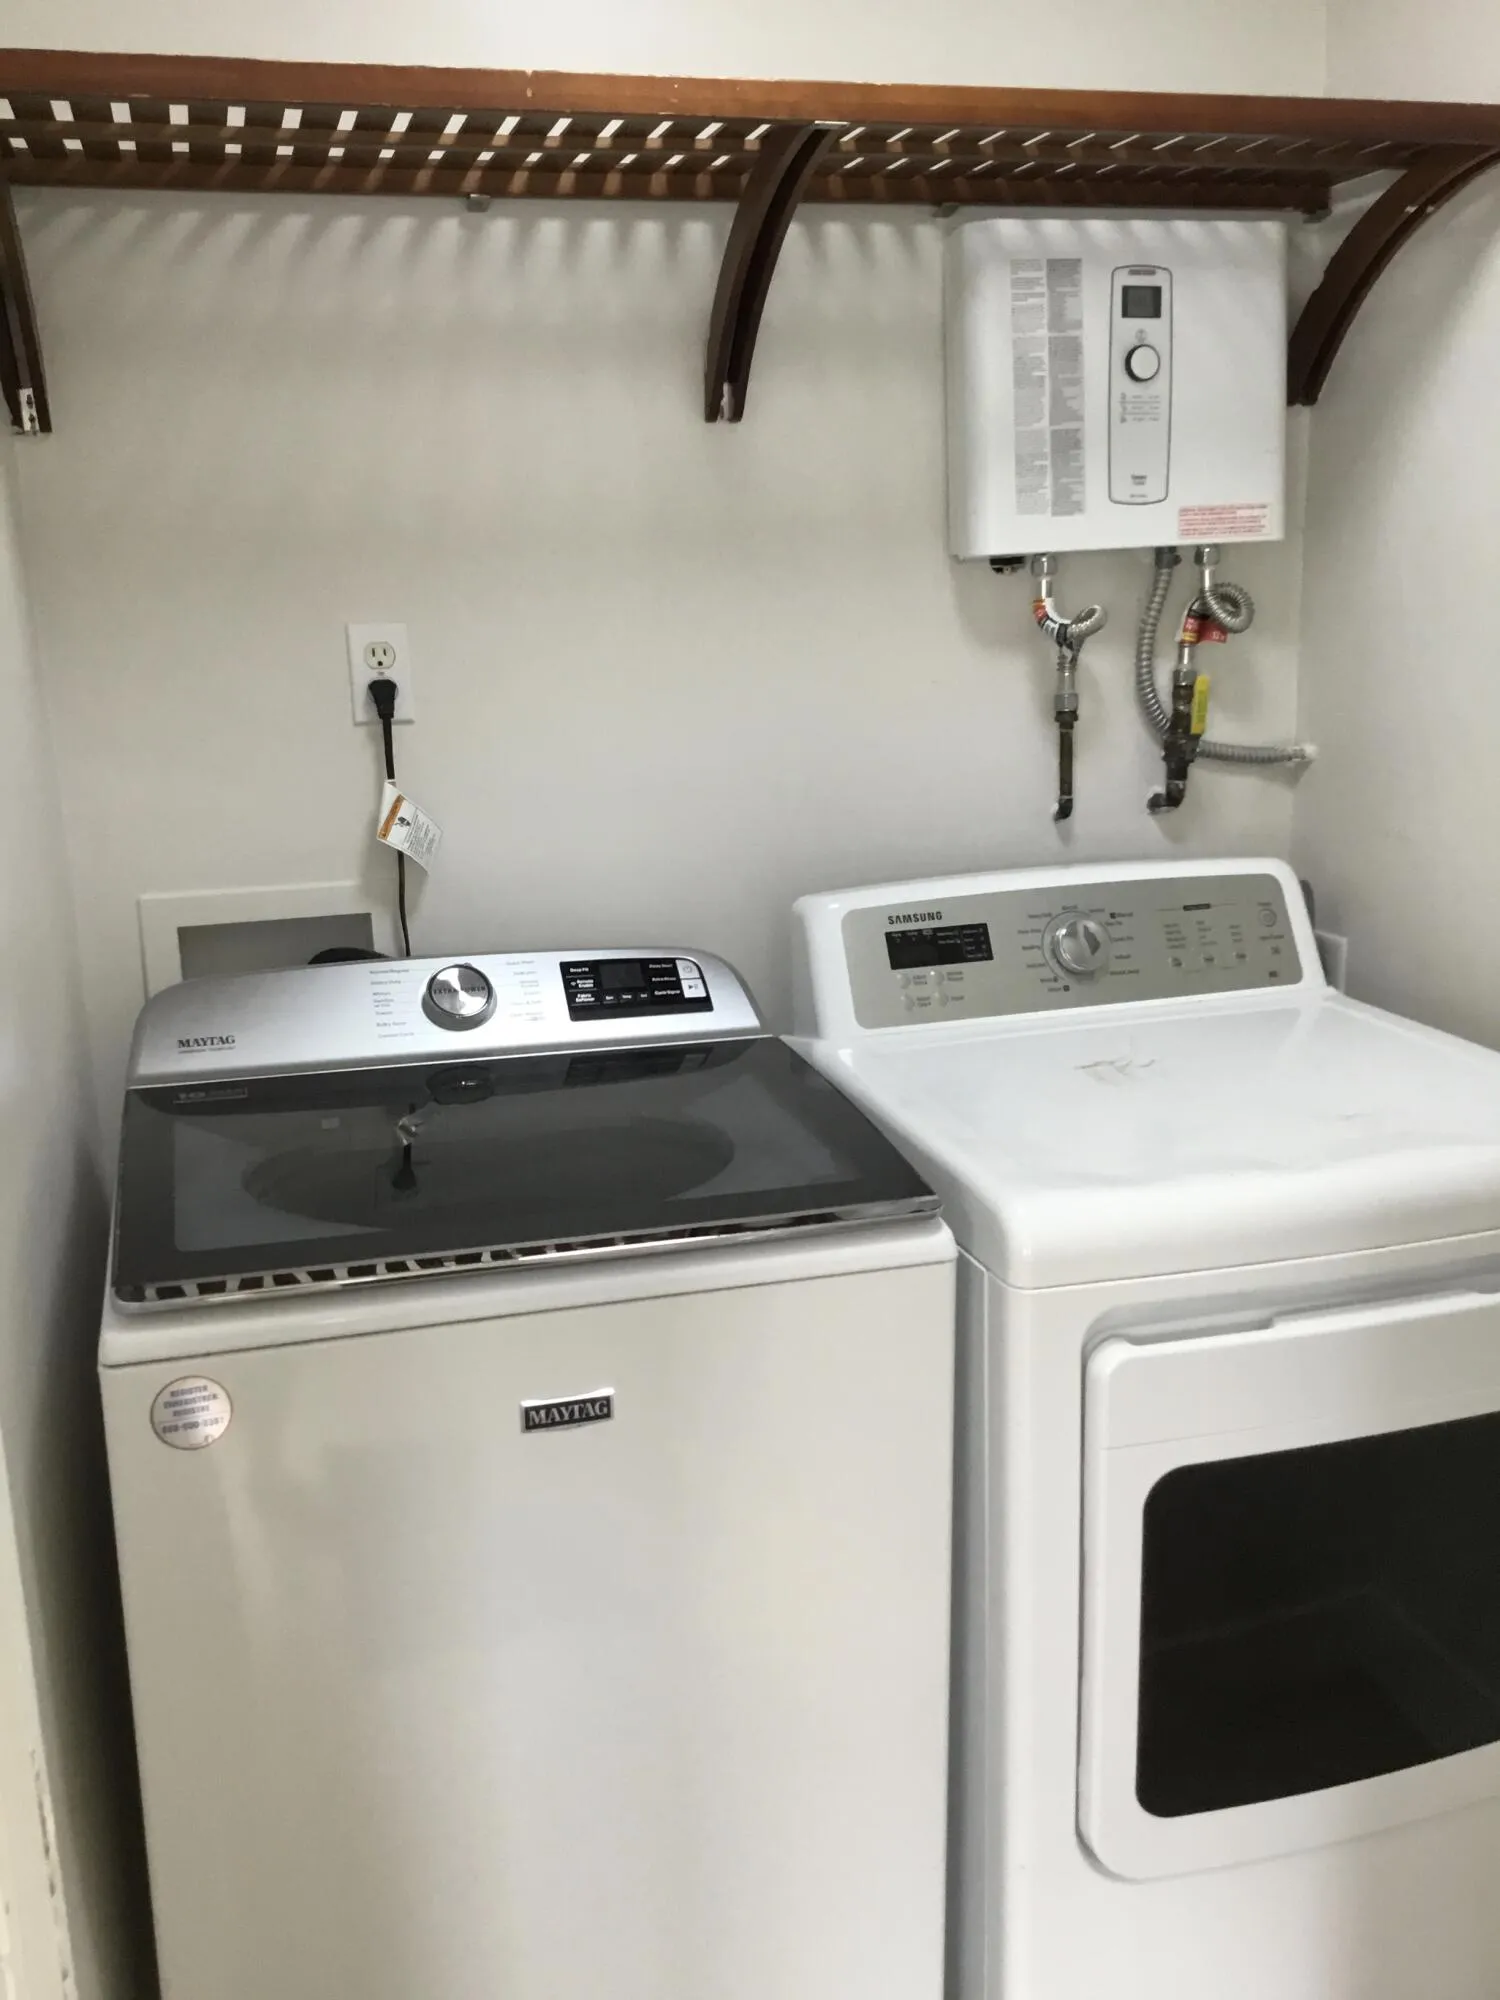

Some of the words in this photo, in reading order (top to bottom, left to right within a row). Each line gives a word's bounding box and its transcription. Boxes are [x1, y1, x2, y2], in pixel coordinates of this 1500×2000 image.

[888, 911, 943, 925] SAMSUNG
[177, 1035, 236, 1049] MAYTAG
[528, 1400, 608, 1426] MAYTAG
